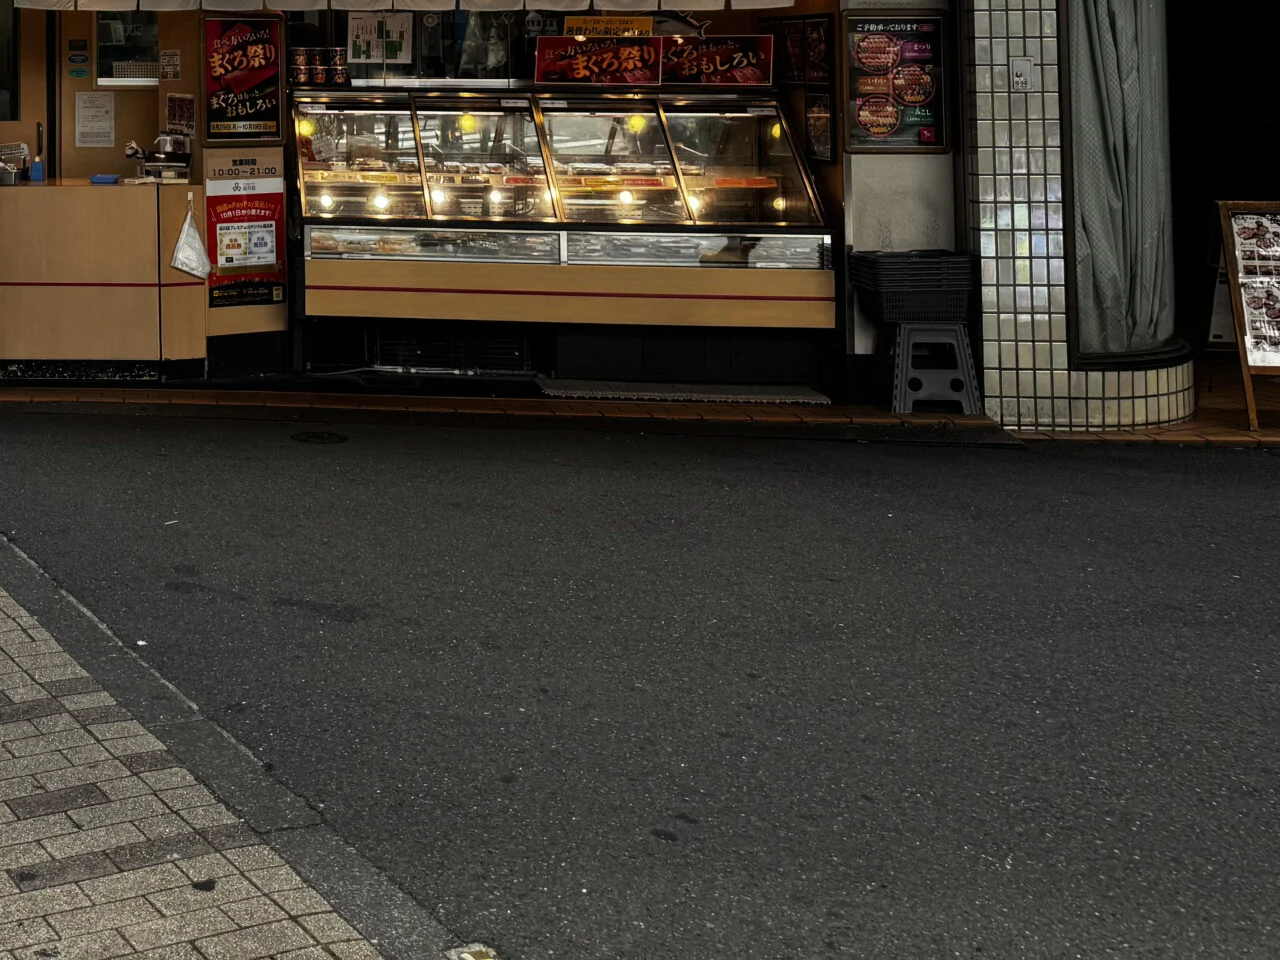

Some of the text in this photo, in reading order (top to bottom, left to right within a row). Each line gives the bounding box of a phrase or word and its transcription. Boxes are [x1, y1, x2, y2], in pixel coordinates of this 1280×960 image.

[208, 43, 276, 77] まぐろ祭り
[571, 45, 656, 79] まぐろ祭り
[682, 51, 766, 76] おもしろい
